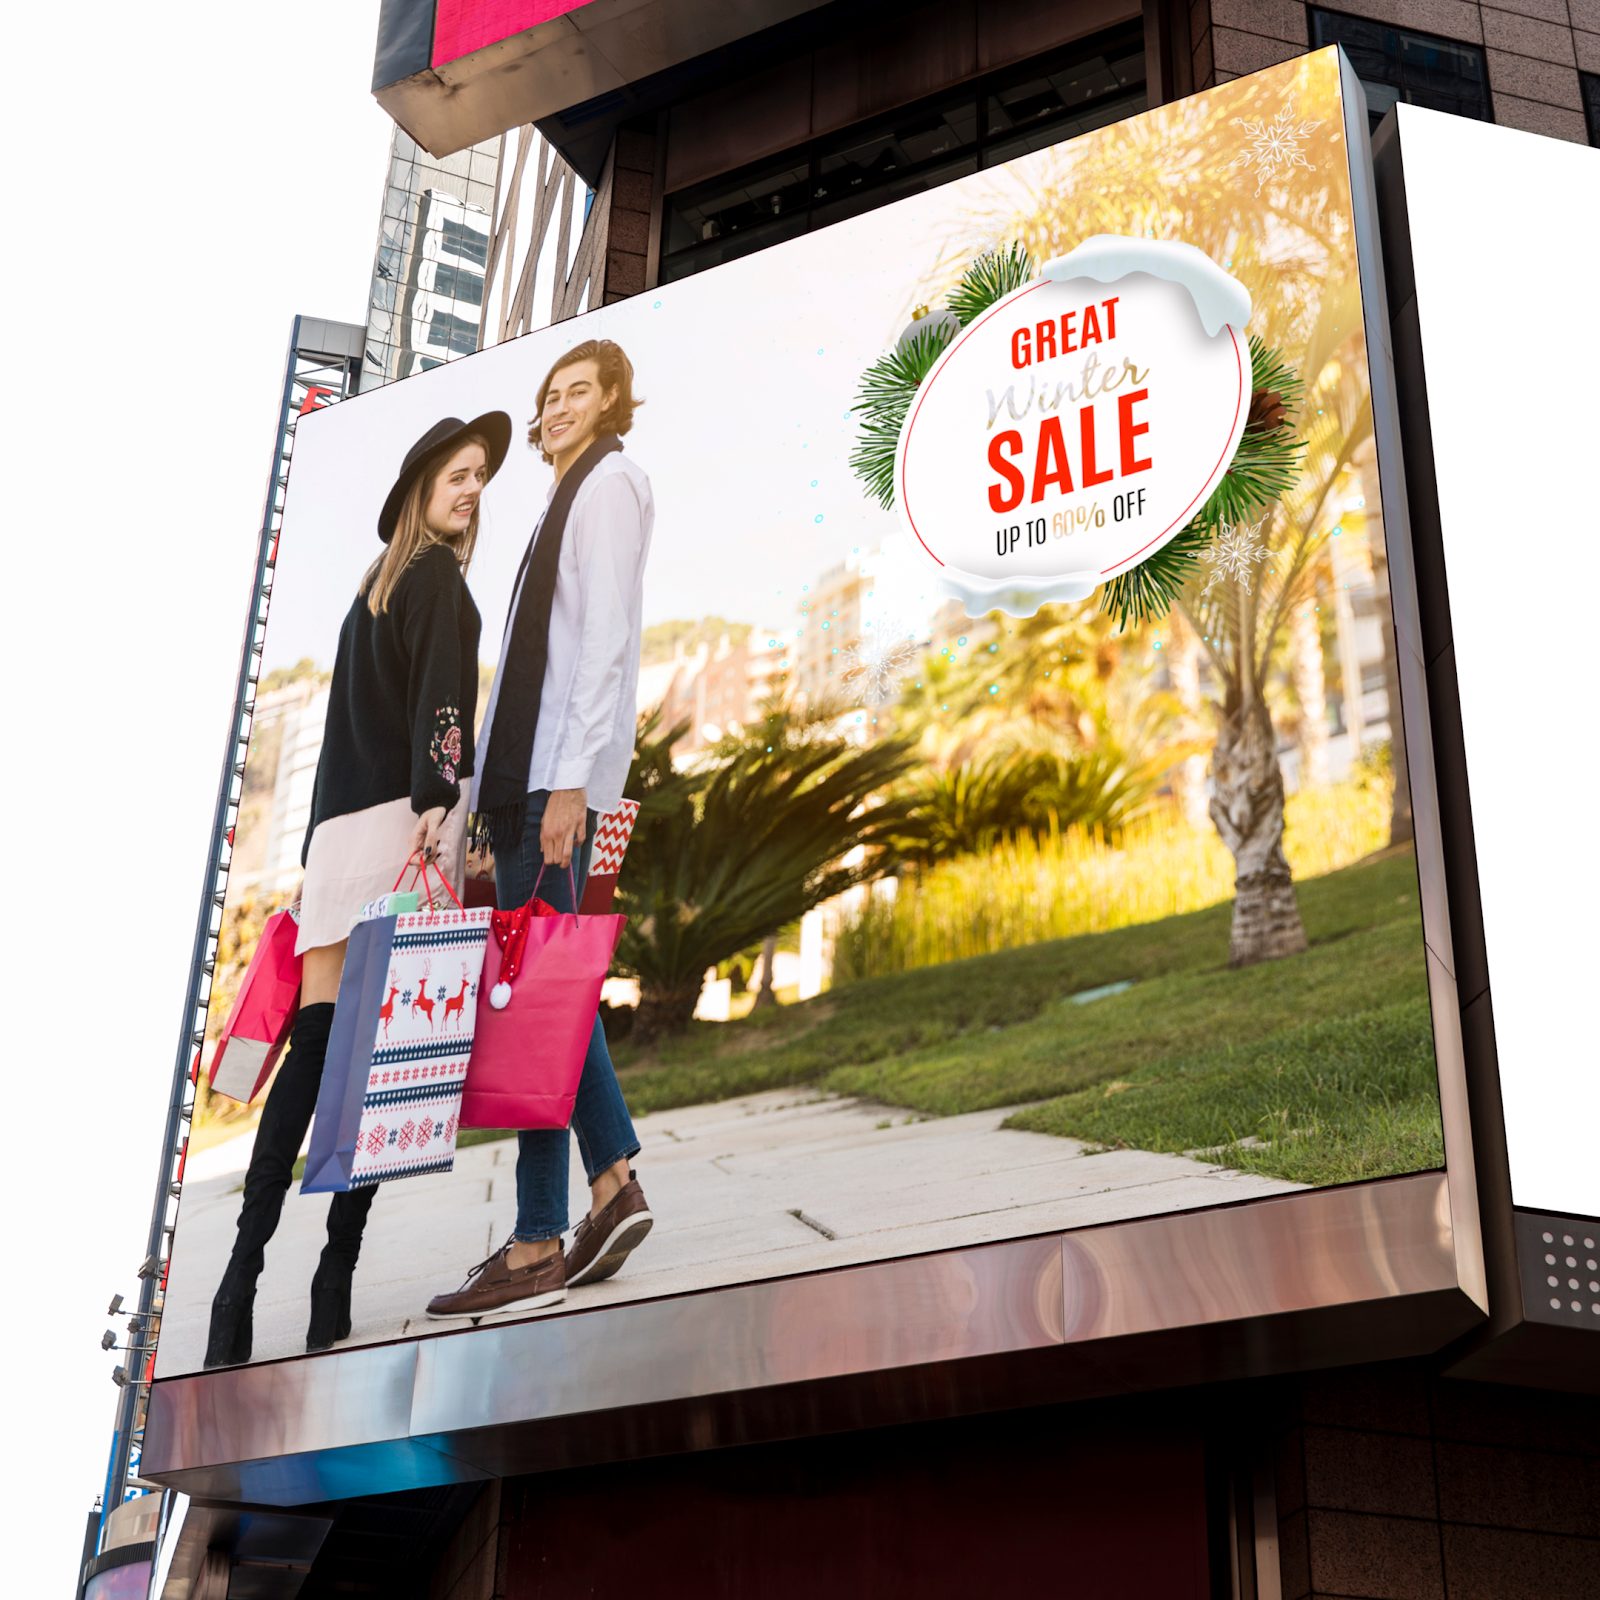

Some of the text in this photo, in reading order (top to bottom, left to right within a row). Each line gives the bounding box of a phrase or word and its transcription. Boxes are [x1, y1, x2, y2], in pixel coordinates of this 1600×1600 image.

[1011, 296, 1119, 370] GREAT
[985, 351, 1150, 431] Winter
[987, 388, 1153, 514] SALE
[996, 487, 1146, 556] UP TO 60% OFF
